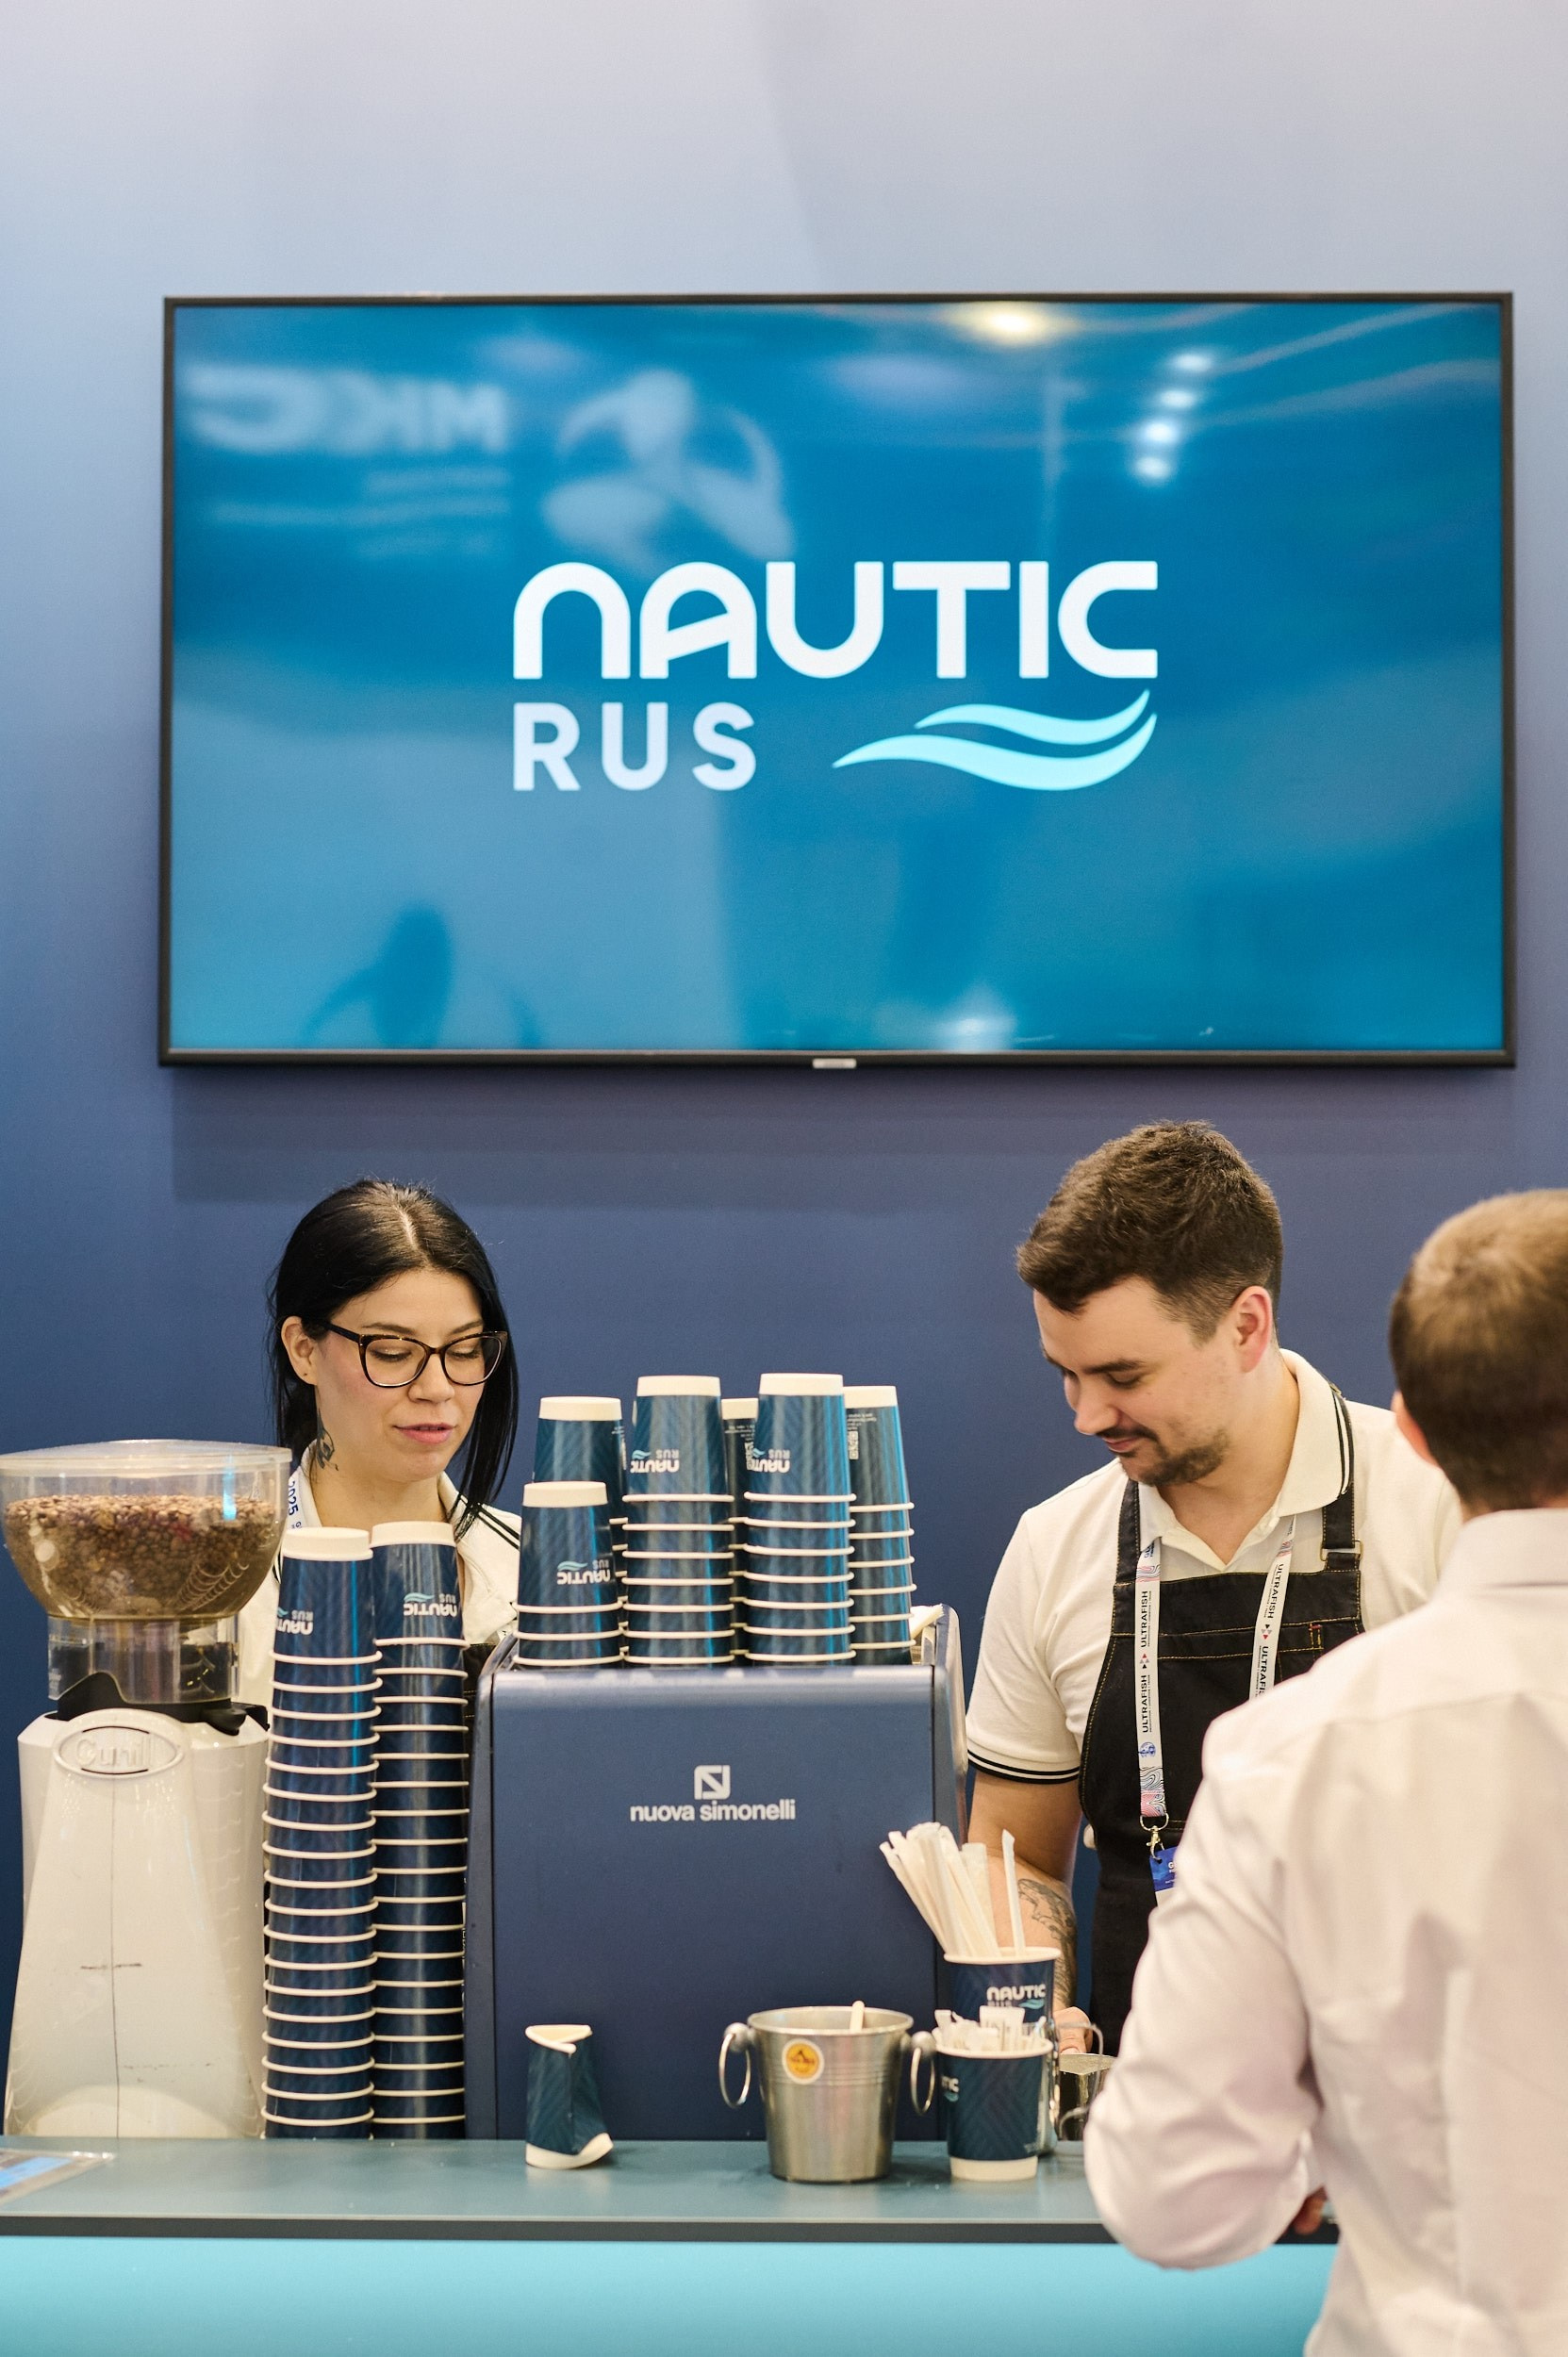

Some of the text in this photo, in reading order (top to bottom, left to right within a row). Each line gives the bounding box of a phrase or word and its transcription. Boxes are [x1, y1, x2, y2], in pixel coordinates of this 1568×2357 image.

[513, 561, 1158, 679] NAUTIC
[513, 701, 755, 790] RUS
[655, 1449, 680, 1459] RUS
[768, 1449, 790, 1459] RUS
[288, 1480, 299, 1516] 2025
[556, 1568, 611, 1586] NAUTIC
[1266, 1564, 1285, 1620] ULTRAFISH
[290, 1610, 314, 1622] RUS
[404, 1603, 458, 1618] NAUTIC
[630, 1799, 797, 1822] nuova simonelli
[987, 1984, 1047, 2001] NAUTIC
